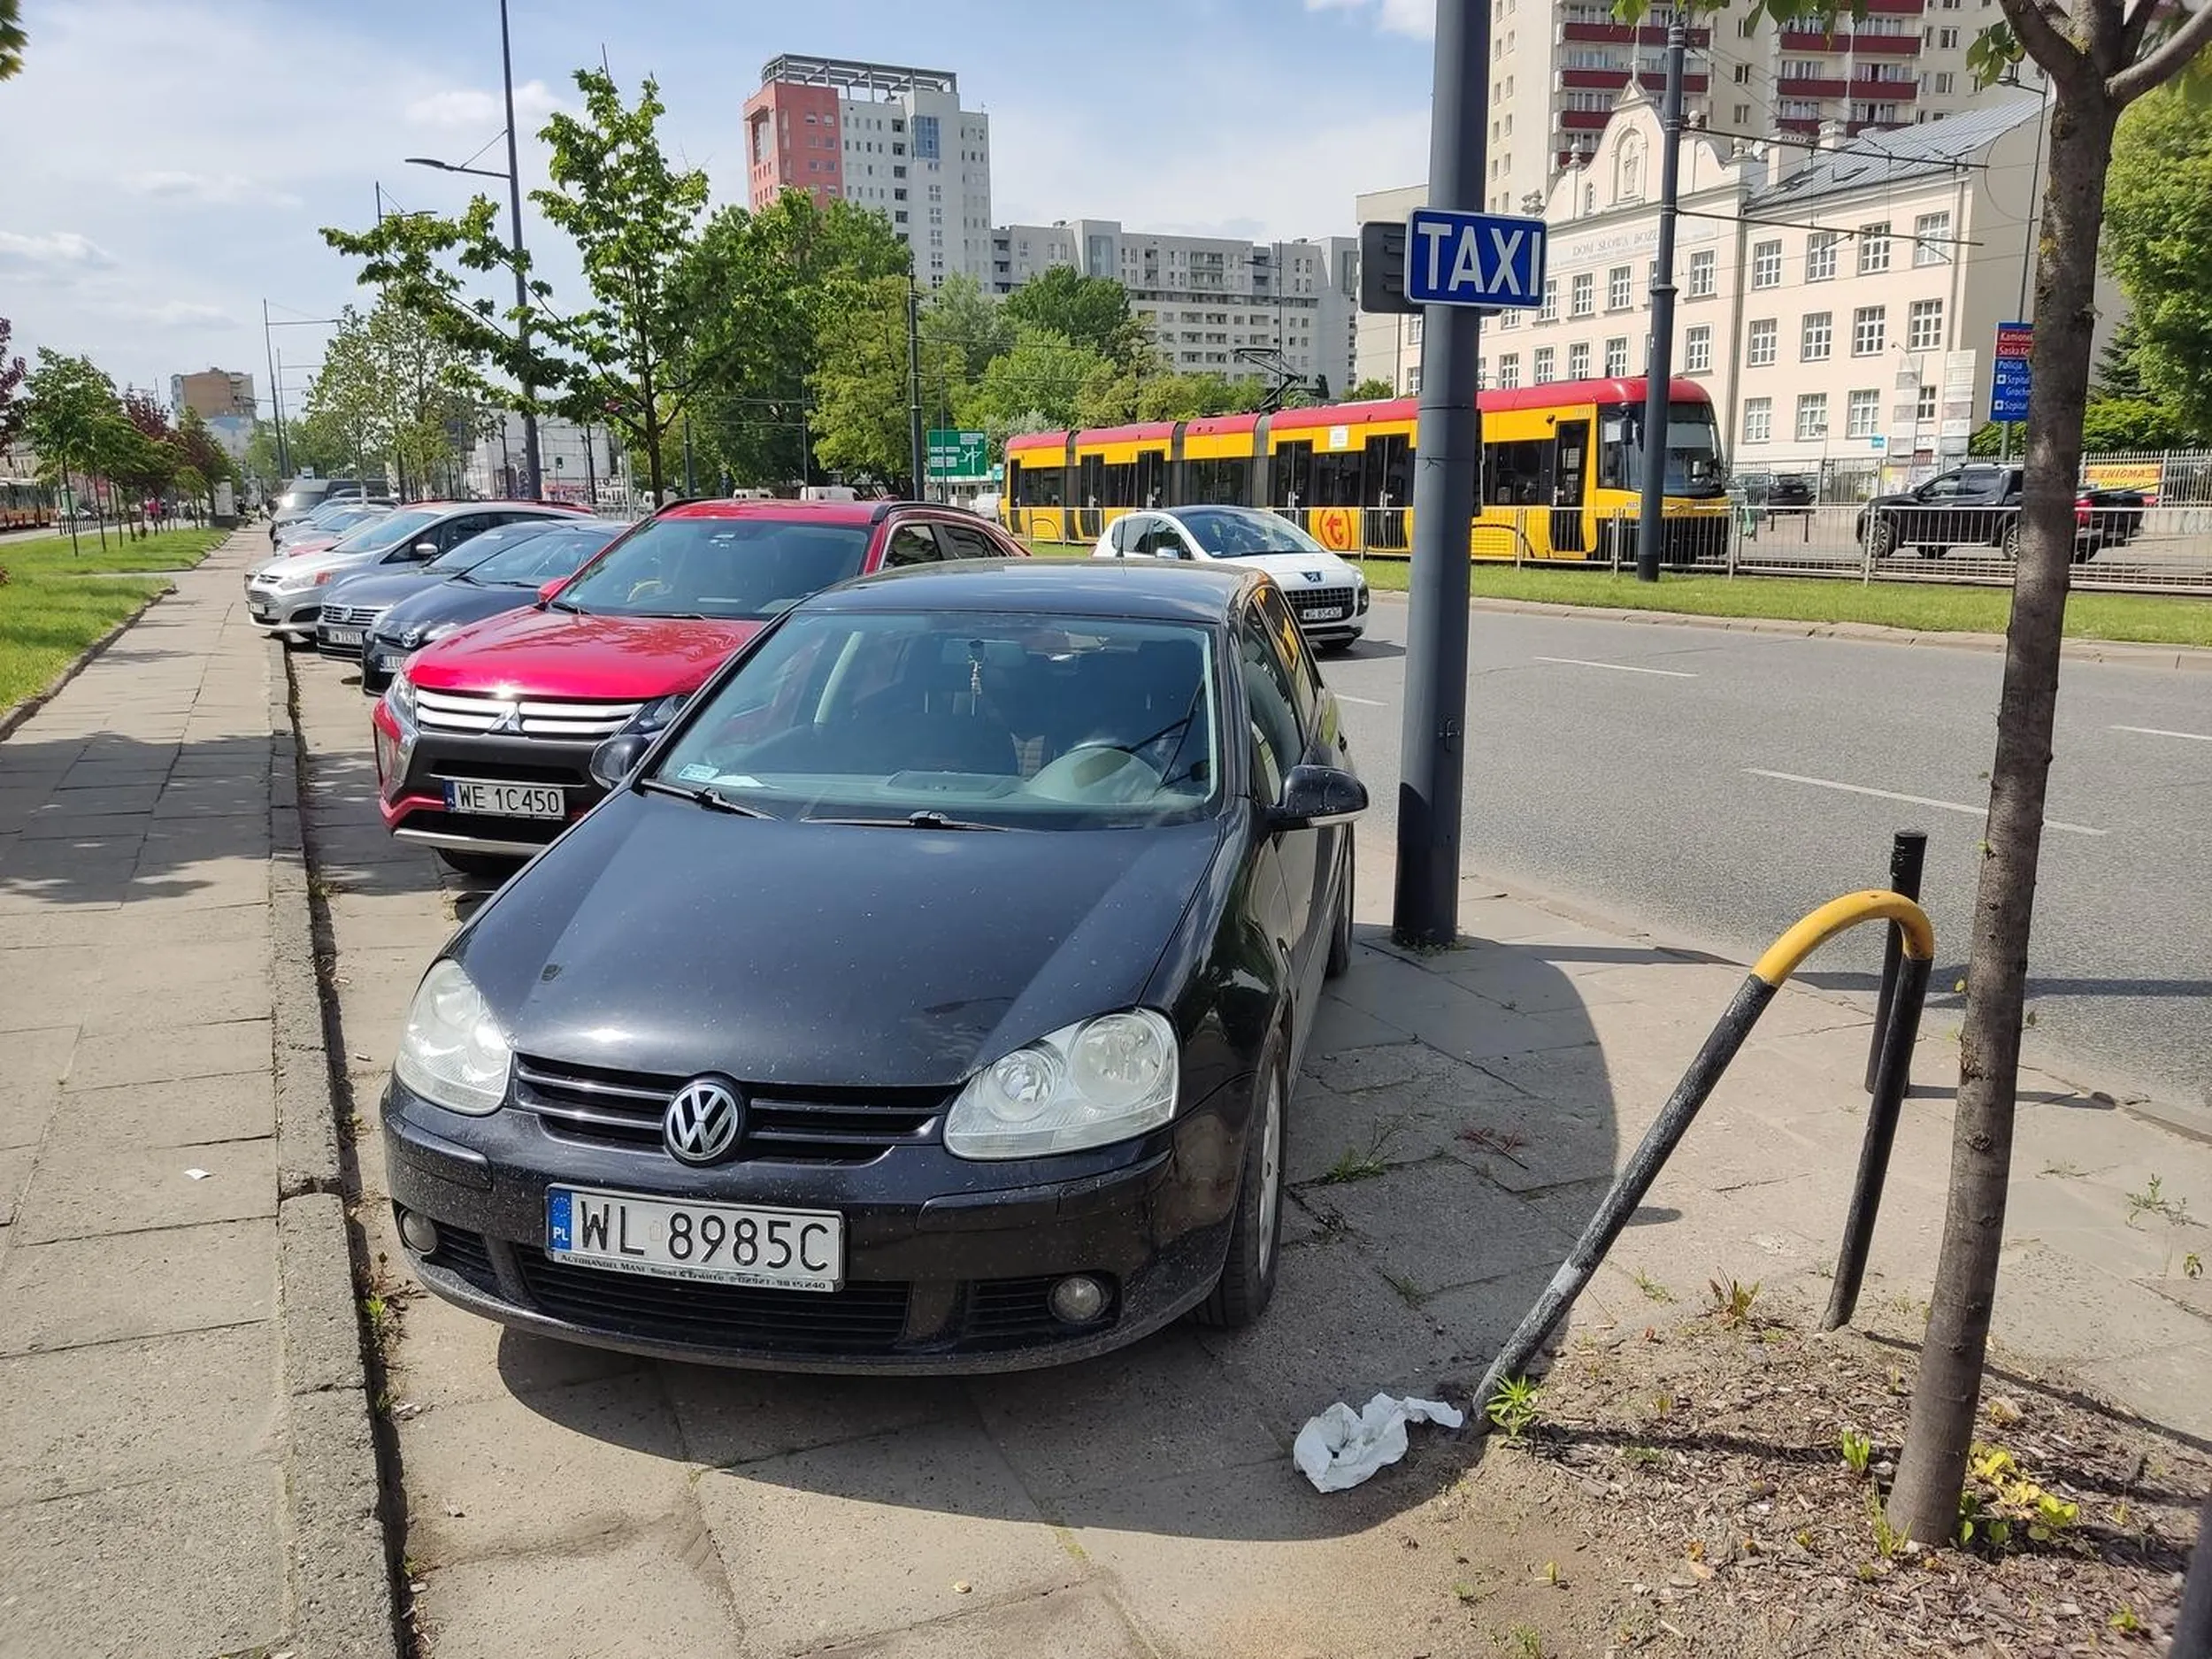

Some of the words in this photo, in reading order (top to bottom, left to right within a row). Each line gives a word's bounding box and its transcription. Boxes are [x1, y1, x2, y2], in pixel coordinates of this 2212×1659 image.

[1417, 222, 1541, 297] TAXI
[1999, 345, 2019, 356] Saska
[1998, 360, 2023, 373] Policja
[2101, 468, 2145, 479] ENIGMA
[458, 785, 485, 809] WE
[495, 787, 559, 813] 1C450
[666, 1083, 738, 1161] VW
[553, 1226, 569, 1241] PL
[580, 1200, 645, 1256] WL
[668, 1211, 829, 1271] 8985C
